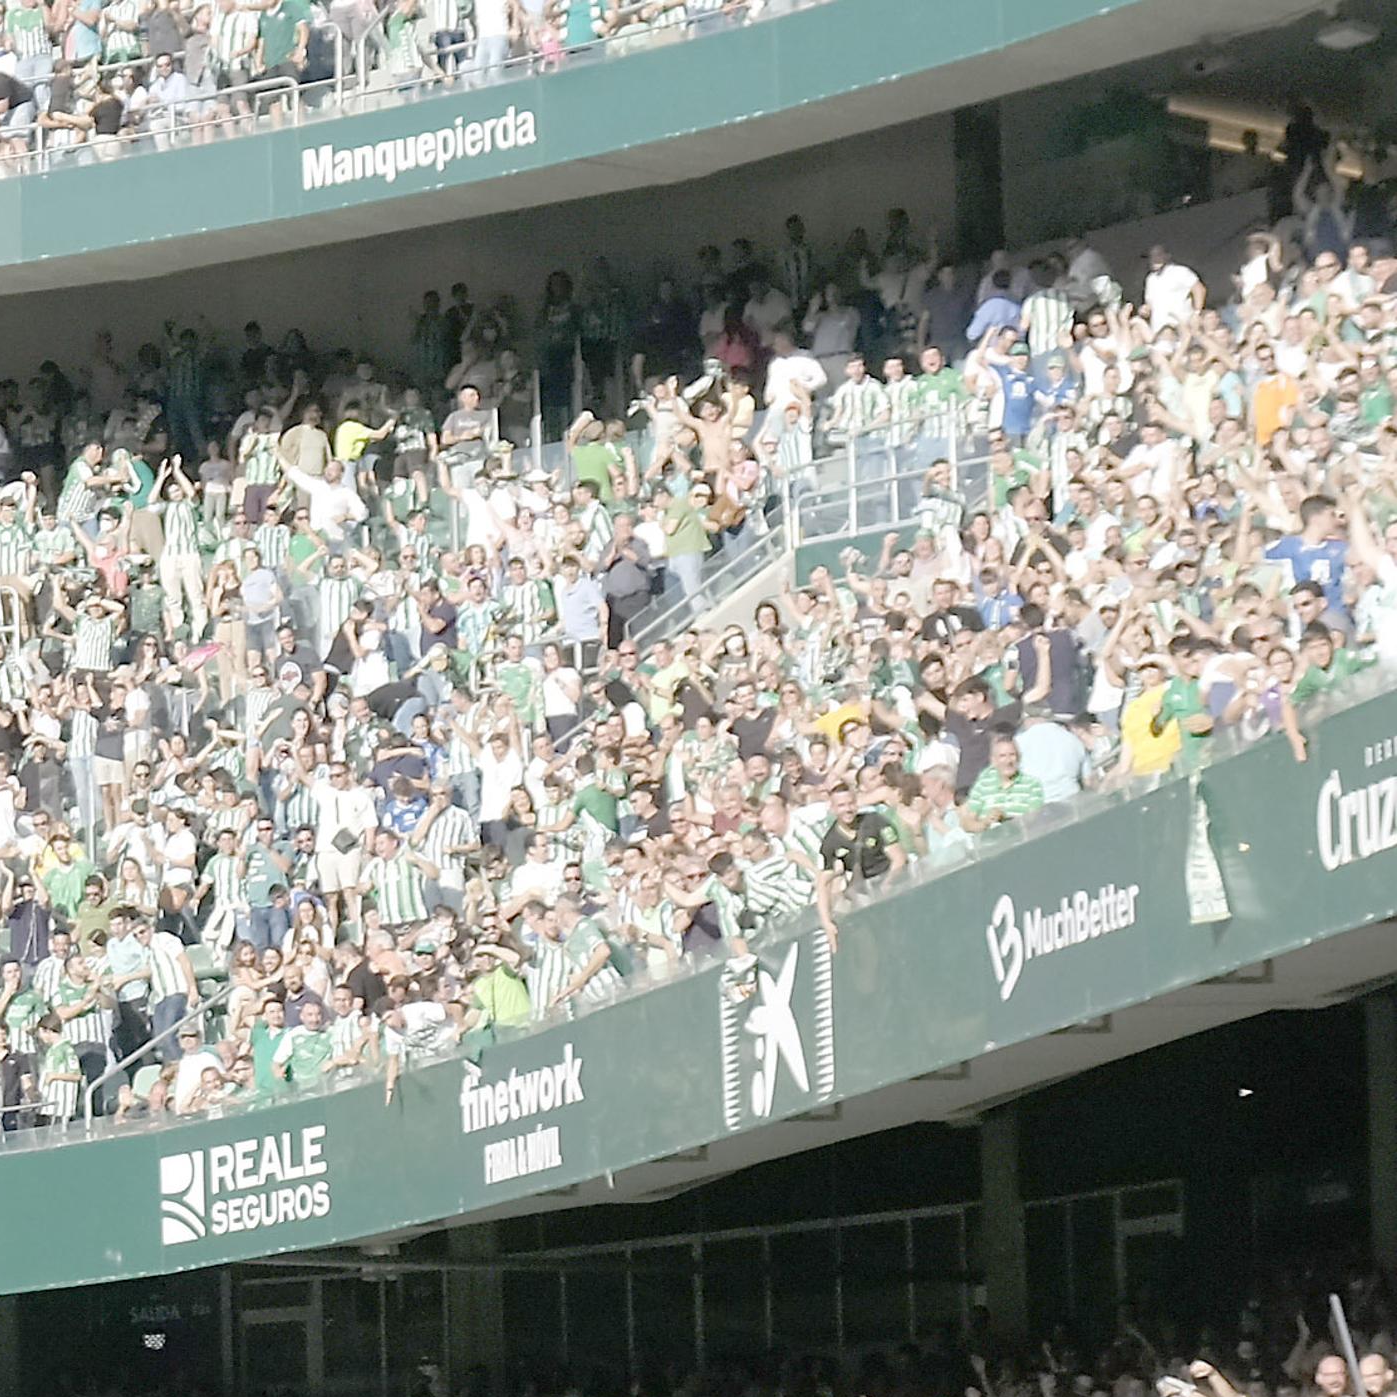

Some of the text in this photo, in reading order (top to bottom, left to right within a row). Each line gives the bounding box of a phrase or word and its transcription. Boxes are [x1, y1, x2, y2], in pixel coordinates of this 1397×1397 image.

[302, 105, 537, 190] Manquepierda
[1024, 884, 1139, 960] MuchBetter
[460, 1042, 584, 1133] finetwork
[210, 1125, 328, 1190] REALE
[211, 1181, 331, 1236] SEGUROS
